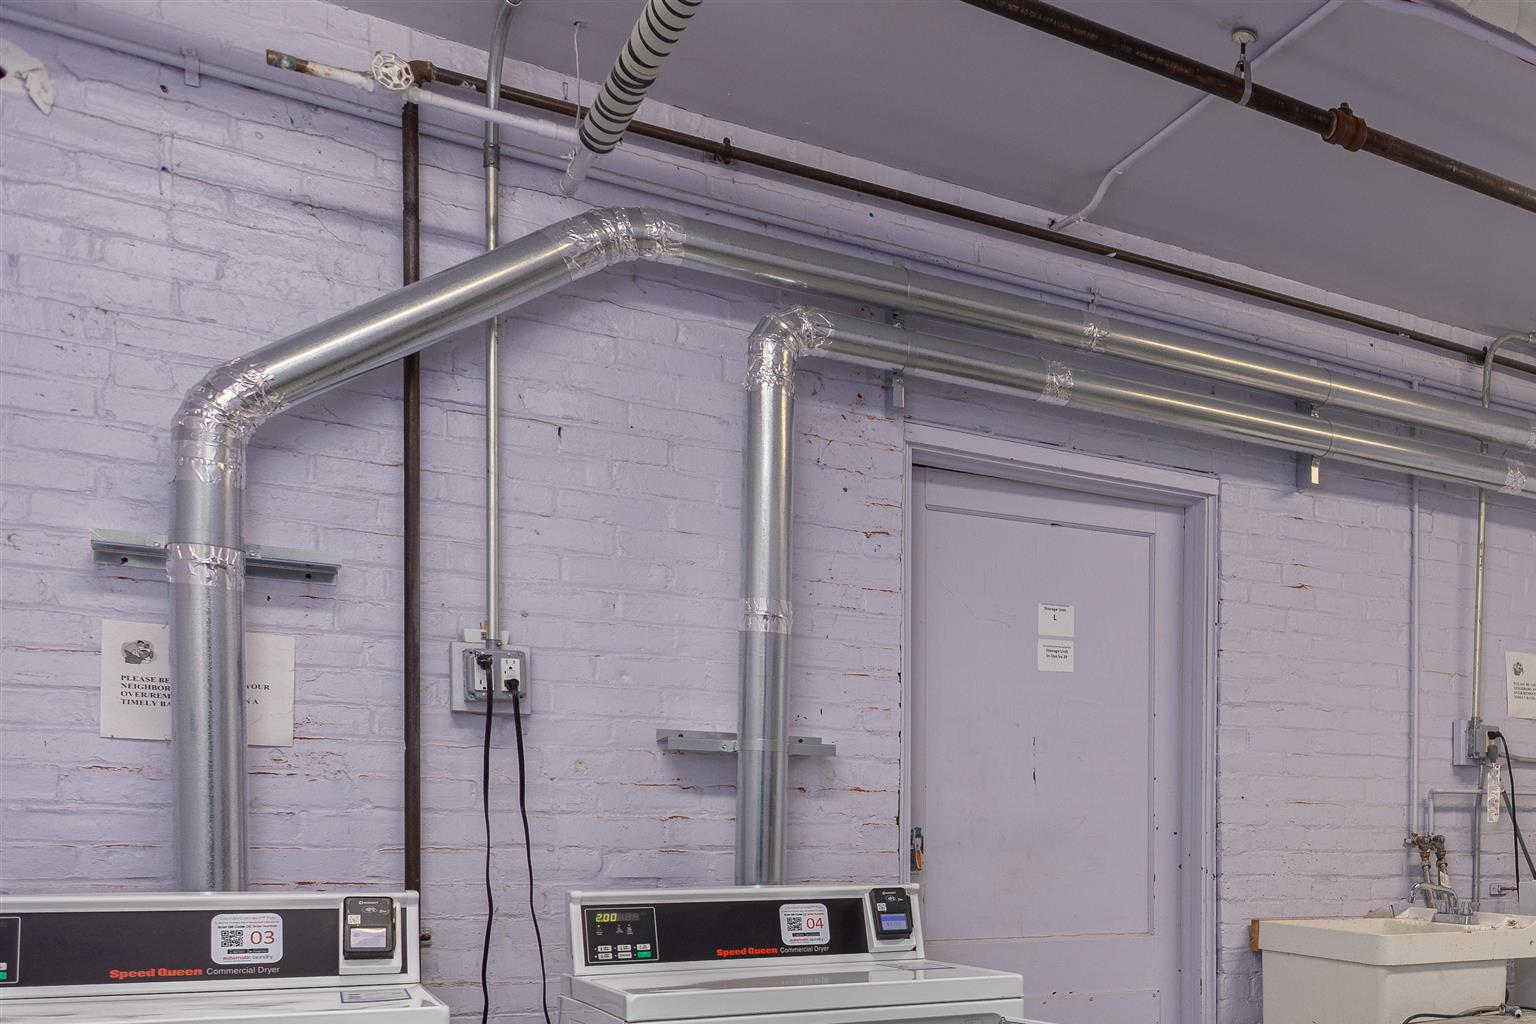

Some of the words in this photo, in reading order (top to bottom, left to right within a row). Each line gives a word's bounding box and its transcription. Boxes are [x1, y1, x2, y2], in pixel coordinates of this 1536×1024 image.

[120, 674, 156, 683] PLEASE
[120, 682, 171, 692] NEIGHBOR
[120, 690, 171, 700] OVER/REM
[120, 698, 158, 707] TIMELY
[806, 918, 824, 929] 04
[250, 930, 275, 944] 03
[716, 947, 746, 957] Speed
[748, 947, 778, 955] Queen
[814, 945, 829, 953] Dryer
[109, 968, 155, 979] Speed
[157, 967, 203, 977] Queen
[206, 967, 255, 975] Commercial
[257, 966, 280, 975] Dryer
